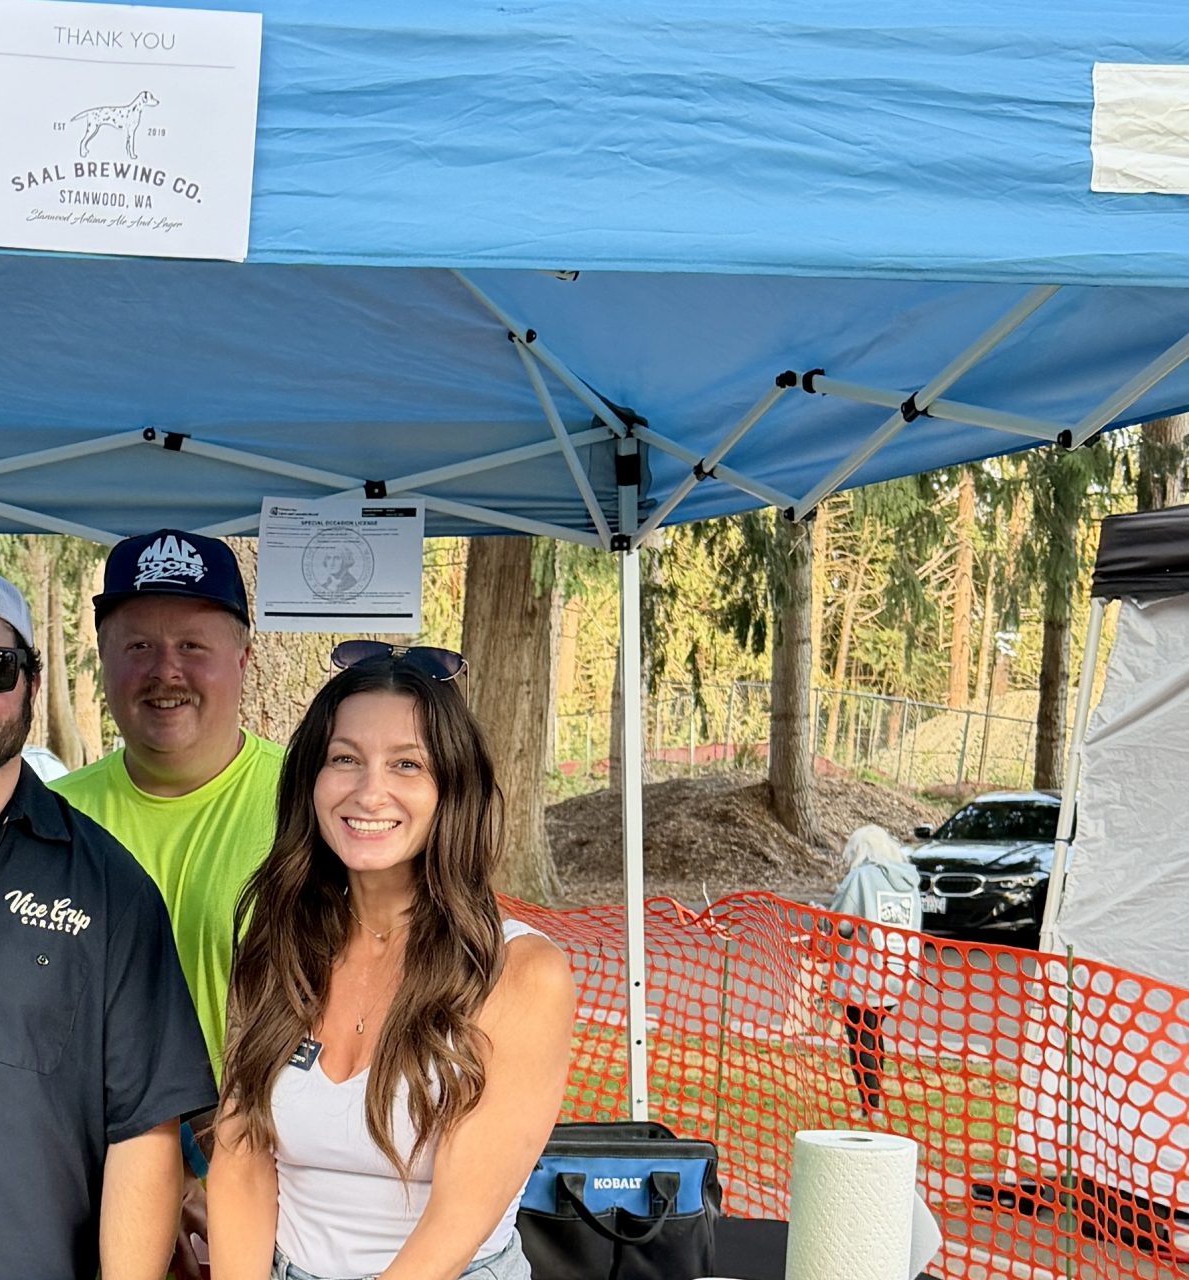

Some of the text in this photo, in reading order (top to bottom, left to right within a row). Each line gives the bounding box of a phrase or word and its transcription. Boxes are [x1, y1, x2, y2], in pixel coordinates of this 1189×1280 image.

[54, 26, 176, 50] THANK YOU
[53, 122, 166, 137] EST 2019
[11, 161, 202, 204] SAAL BREWING CO.
[59, 189, 153, 210] STANWOOD, WA
[138, 534, 204, 566] MAC
[137, 560, 204, 574] TOOLS
[4, 890, 91, 936] Vice Grip
[21, 916, 72, 933] GARAGE
[593, 1178, 643, 1190] KOBALT
